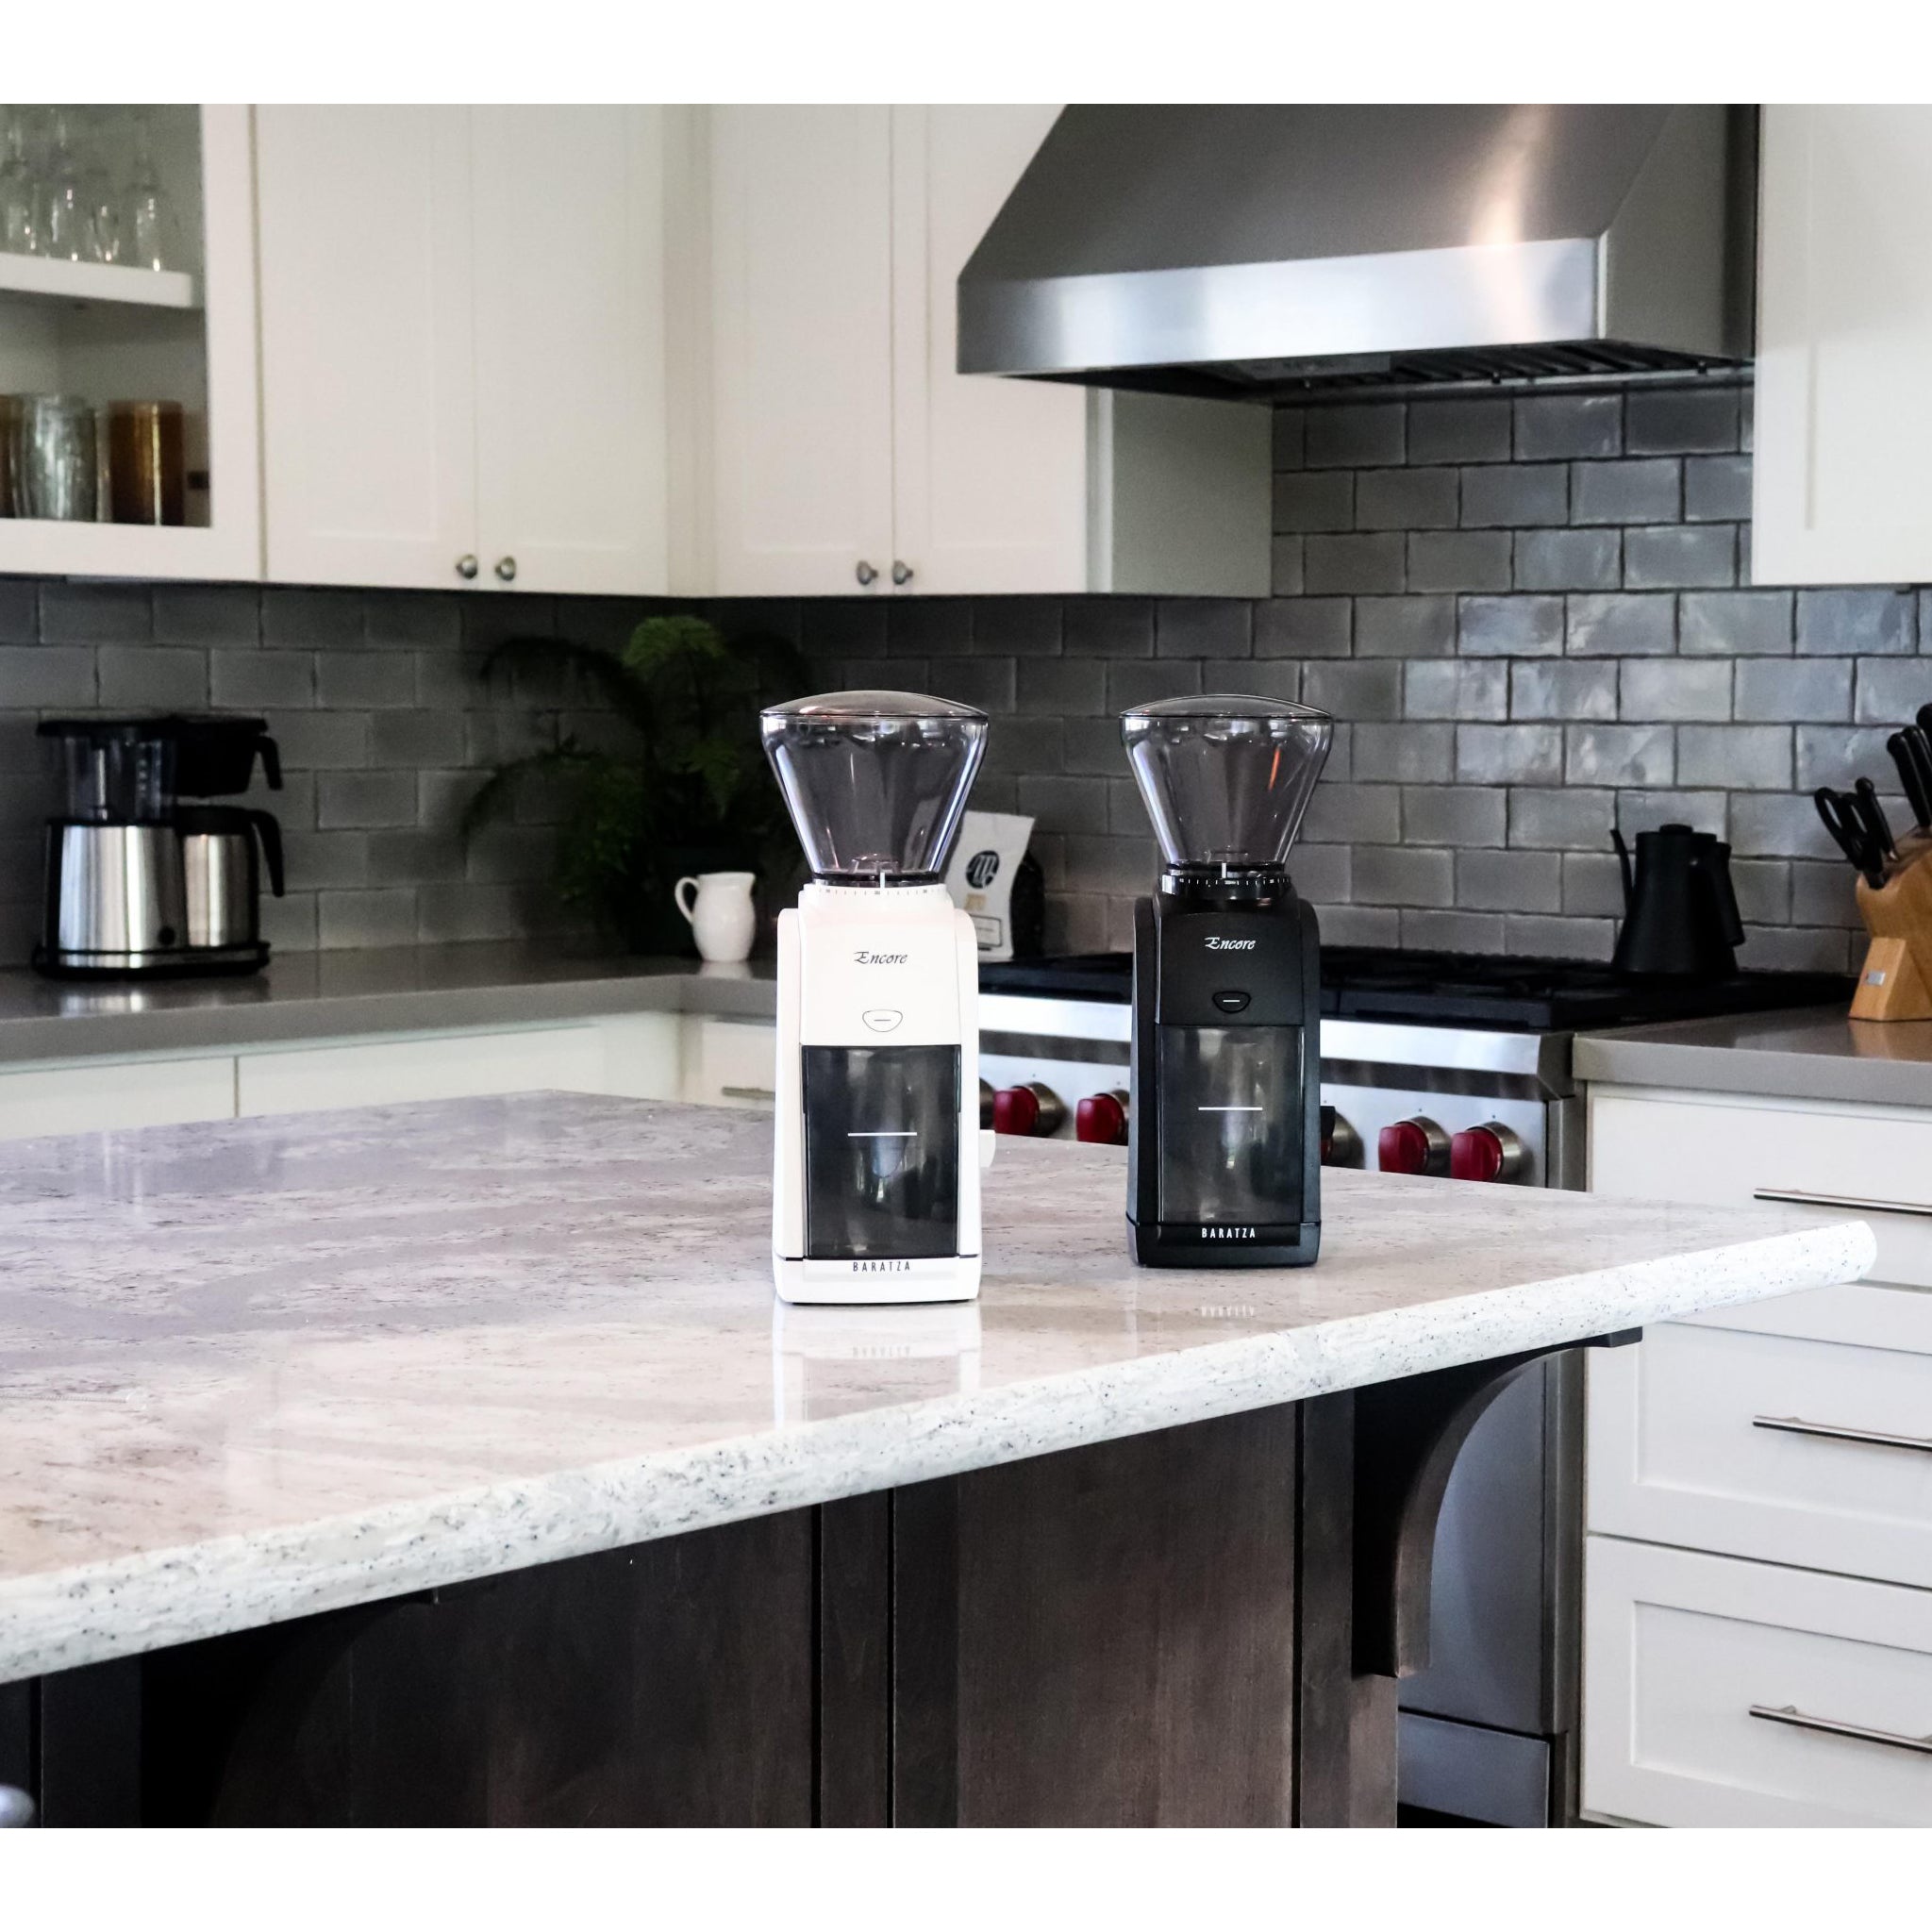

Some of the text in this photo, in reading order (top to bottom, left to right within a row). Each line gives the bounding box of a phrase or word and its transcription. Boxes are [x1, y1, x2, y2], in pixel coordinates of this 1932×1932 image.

[1204, 937, 1257, 950] Encore
[853, 951, 908, 964] Encore
[1201, 1227, 1256, 1239] BARATZA
[853, 1261, 910, 1272] BARATZA
